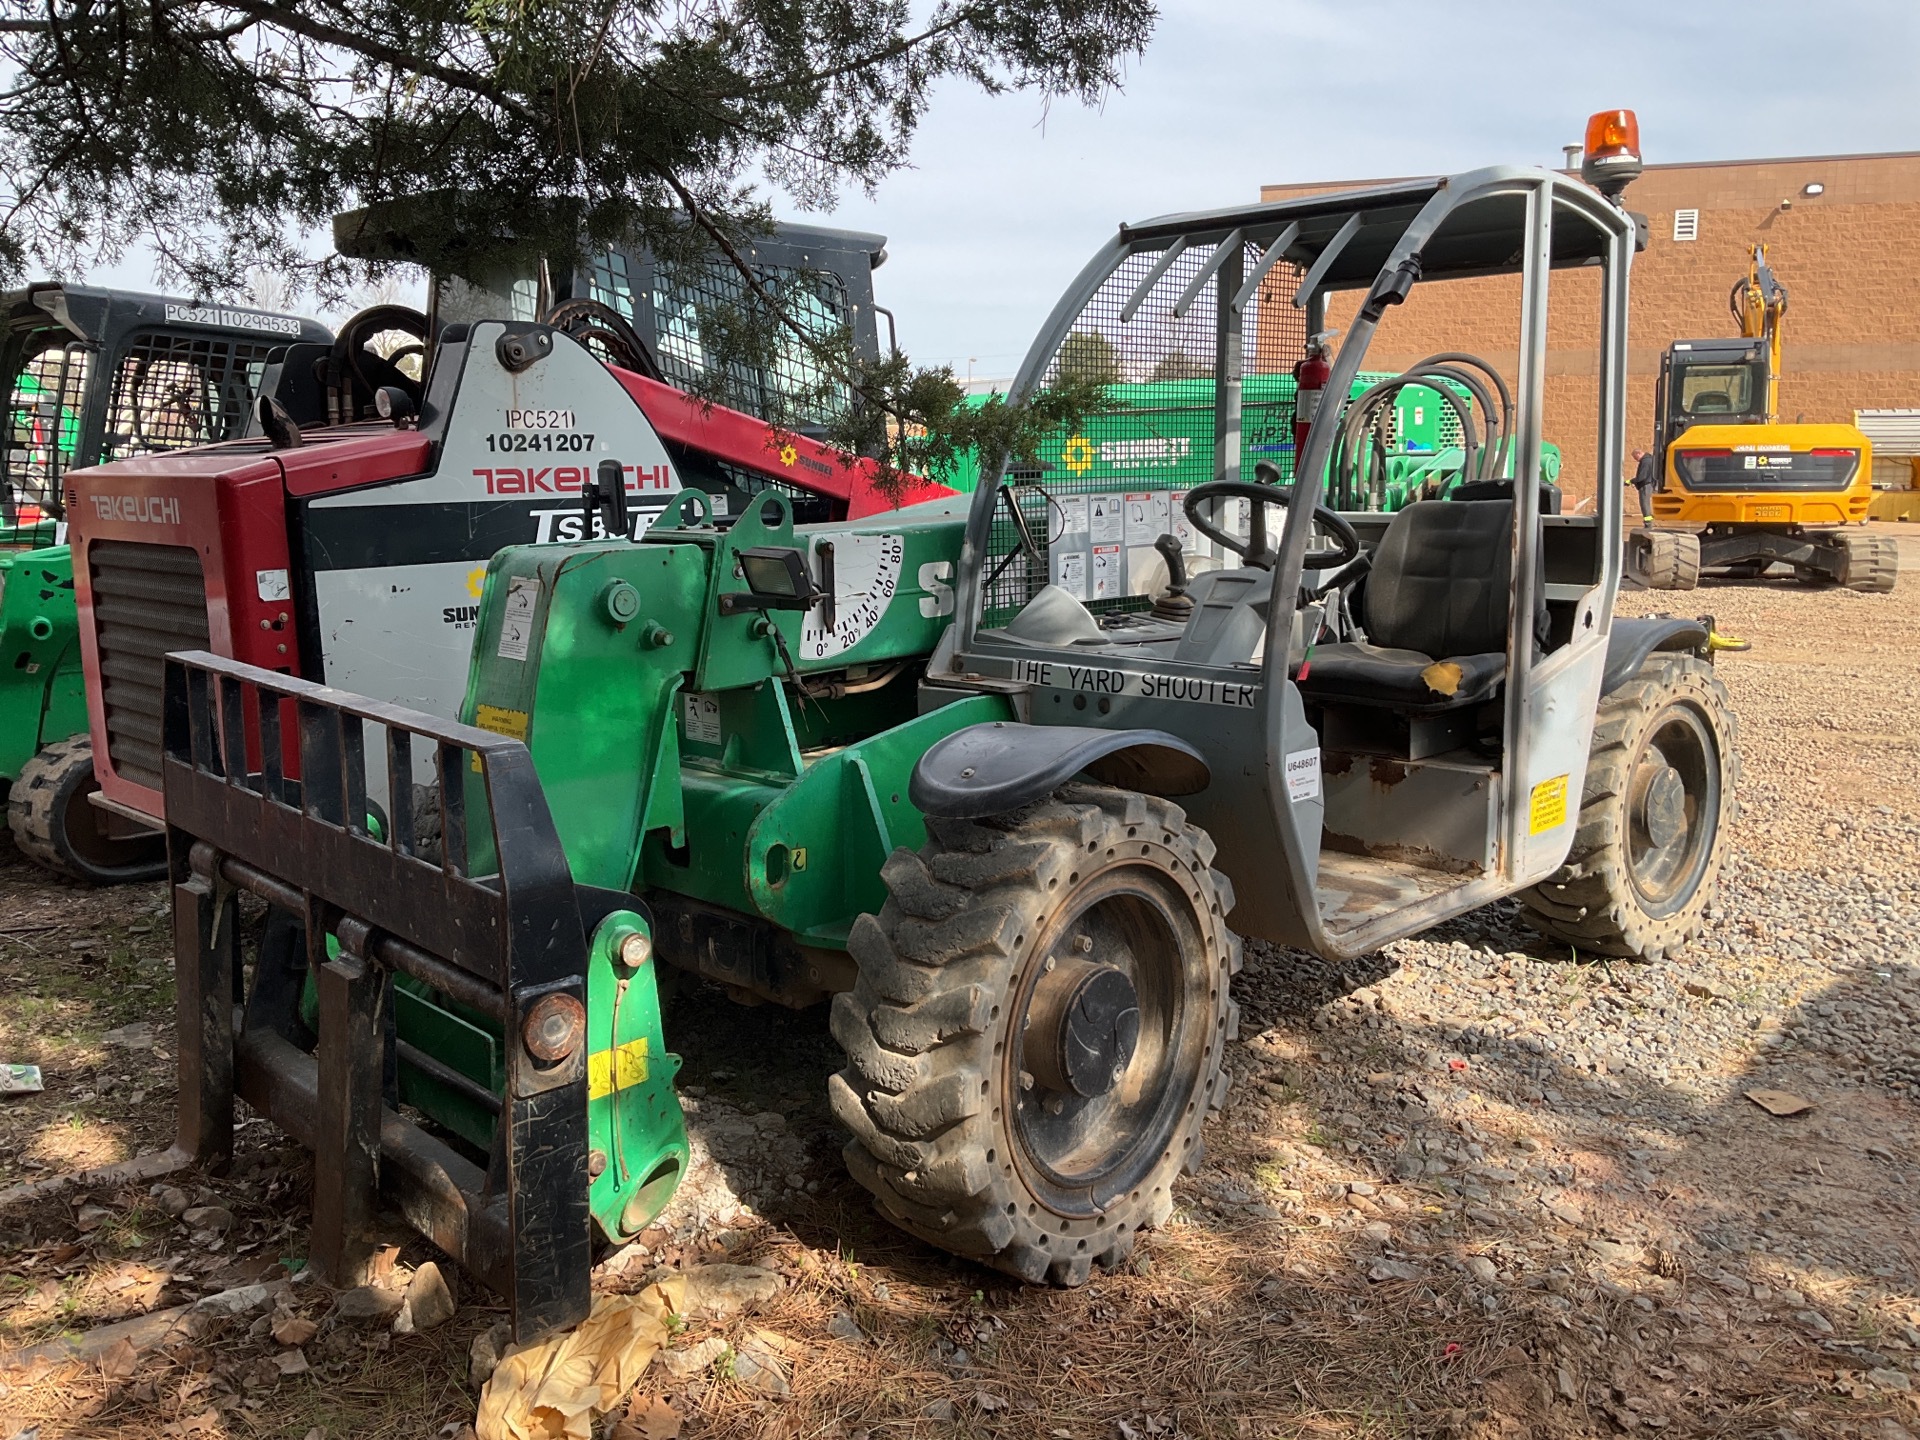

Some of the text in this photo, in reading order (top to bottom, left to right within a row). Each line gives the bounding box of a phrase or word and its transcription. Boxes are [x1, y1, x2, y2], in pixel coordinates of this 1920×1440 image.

[166, 304, 300, 334] PC521 10299533
[486, 433, 596, 452] 10241207
[89, 495, 181, 525] TAKEUCHI
[1016, 659, 1254, 707] THE YARD SHOOTER
